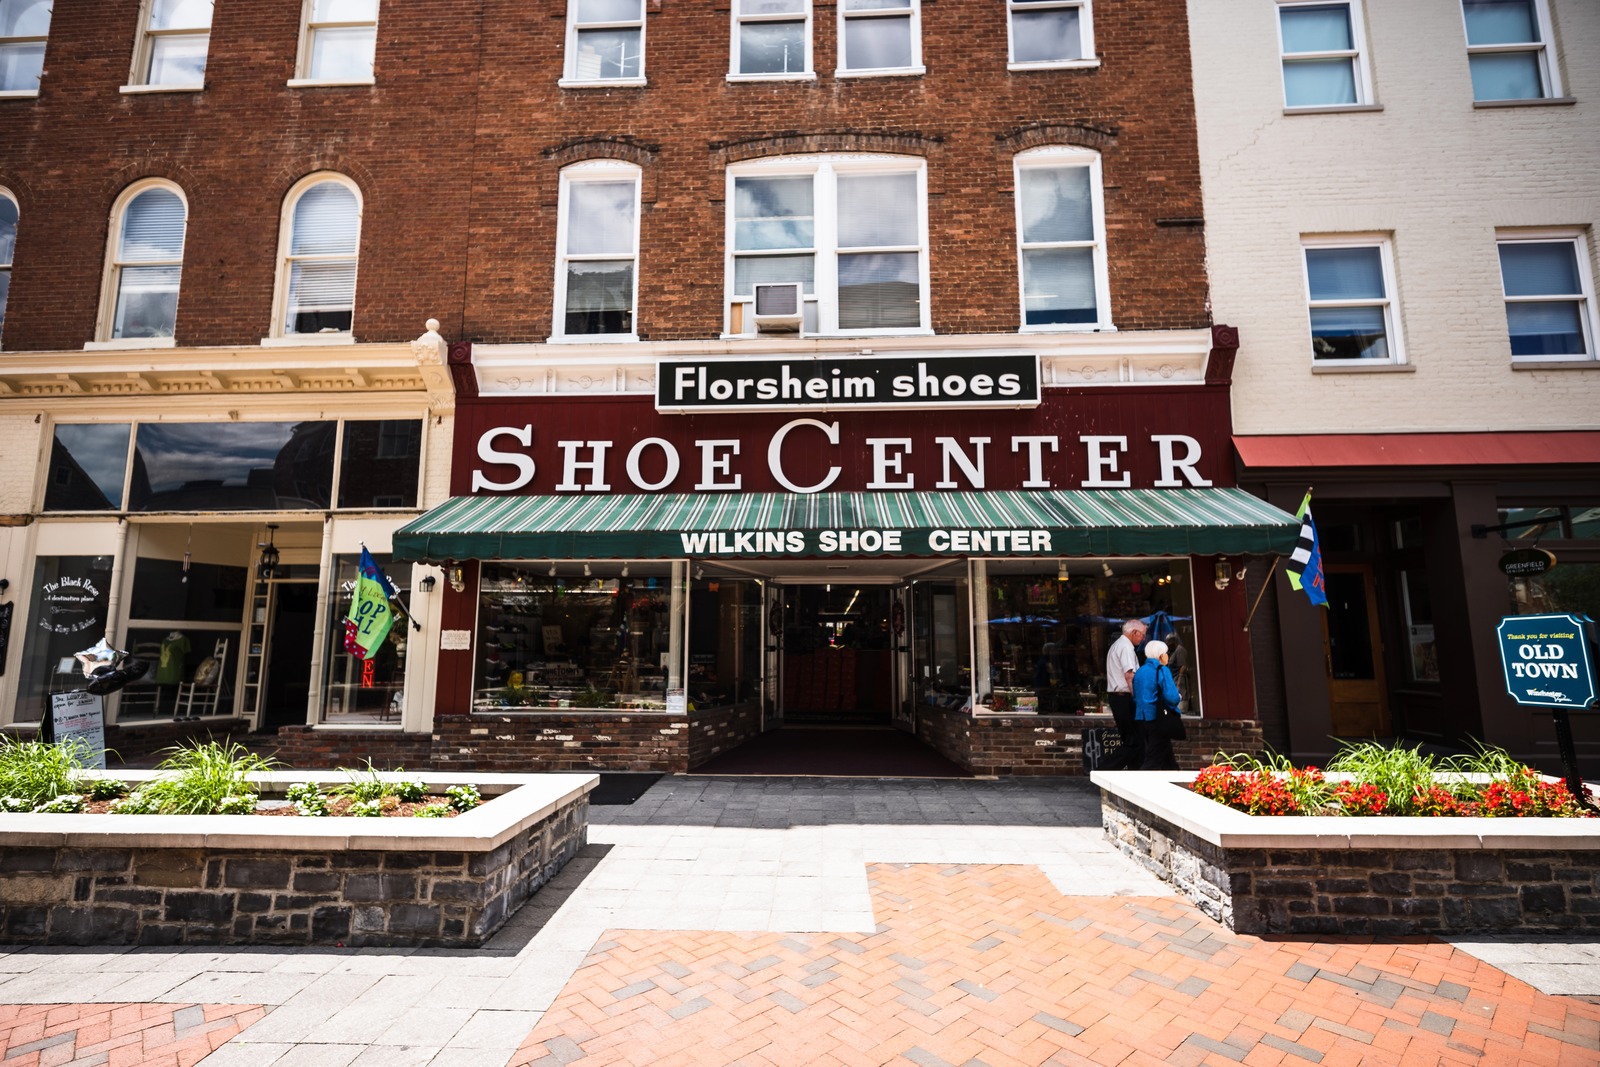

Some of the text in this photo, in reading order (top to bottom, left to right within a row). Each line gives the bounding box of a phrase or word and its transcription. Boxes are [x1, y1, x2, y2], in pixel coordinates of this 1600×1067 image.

[675, 362, 1021, 400] Florsheim shoes
[472, 418, 1213, 493] SHOE CENTER
[680, 530, 1052, 553] WILKINS SHOE CENTER
[1505, 560, 1544, 570] GREENFIELD
[43, 576, 99, 597] The Black Rose
[51, 594, 80, 602] destination
[80, 595, 95, 603] place
[1549, 632, 1575, 640] visiting
[1518, 644, 1564, 660] OLD
[1511, 662, 1578, 679] TOWN
[1526, 688, 1562, 698] Winchester
